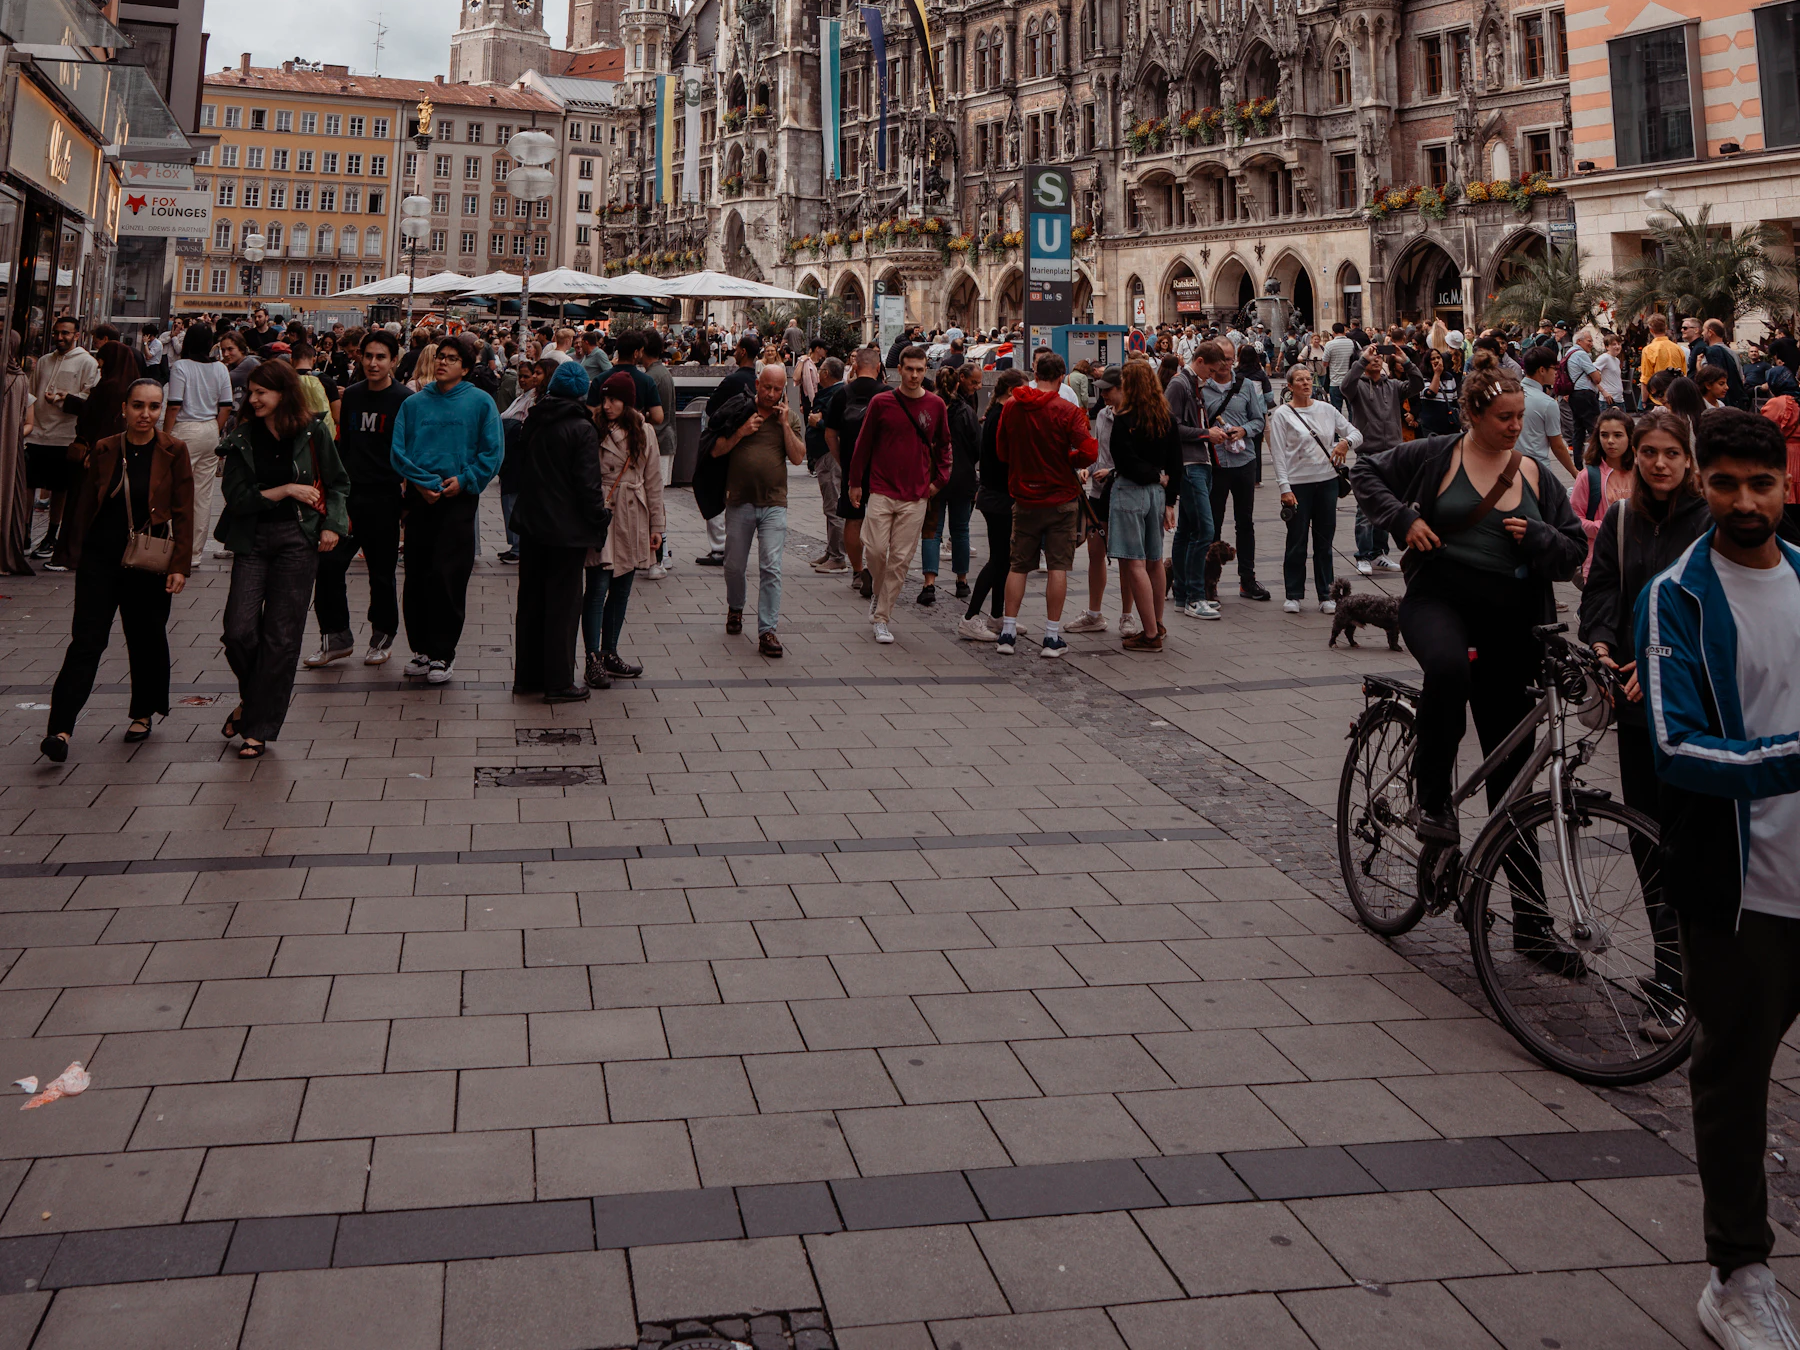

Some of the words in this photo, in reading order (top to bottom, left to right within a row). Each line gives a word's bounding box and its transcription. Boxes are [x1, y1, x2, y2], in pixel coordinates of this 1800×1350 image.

[1038, 172, 1063, 207] S
[152, 197, 177, 207] FOX
[151, 207, 207, 218] LOUNGES
[1038, 218, 1061, 253] U
[1031, 267, 1070, 276] Marienplatz
